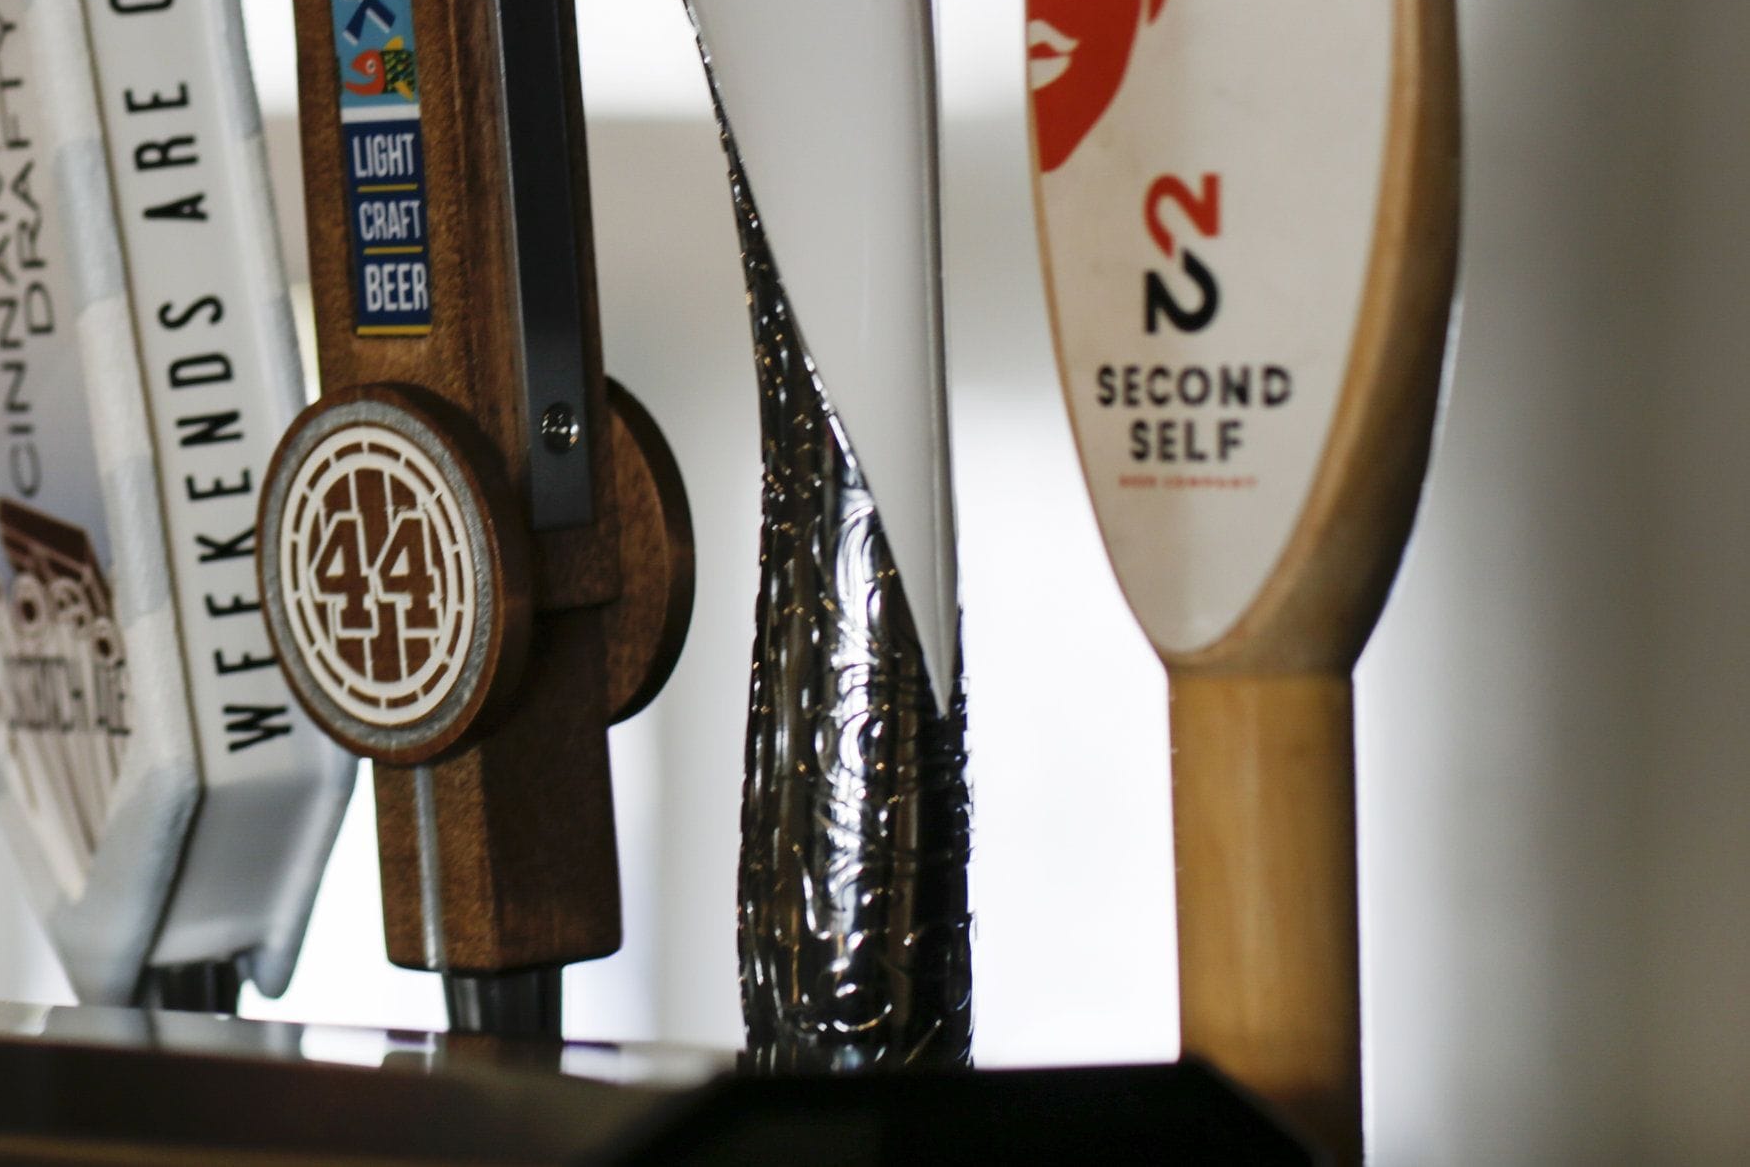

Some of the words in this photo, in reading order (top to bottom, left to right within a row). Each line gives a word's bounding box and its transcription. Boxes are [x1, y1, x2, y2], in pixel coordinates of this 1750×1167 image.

[124, 81, 210, 222] ARE
[352, 133, 415, 179] LIGHT
[358, 199, 422, 242] CRAFT
[363, 262, 429, 313] BEER
[1096, 364, 1293, 408] SECOND
[1129, 418, 1244, 464] SELF
[158, 294, 294, 755] WEEKENDS
[309, 510, 444, 639] 44
